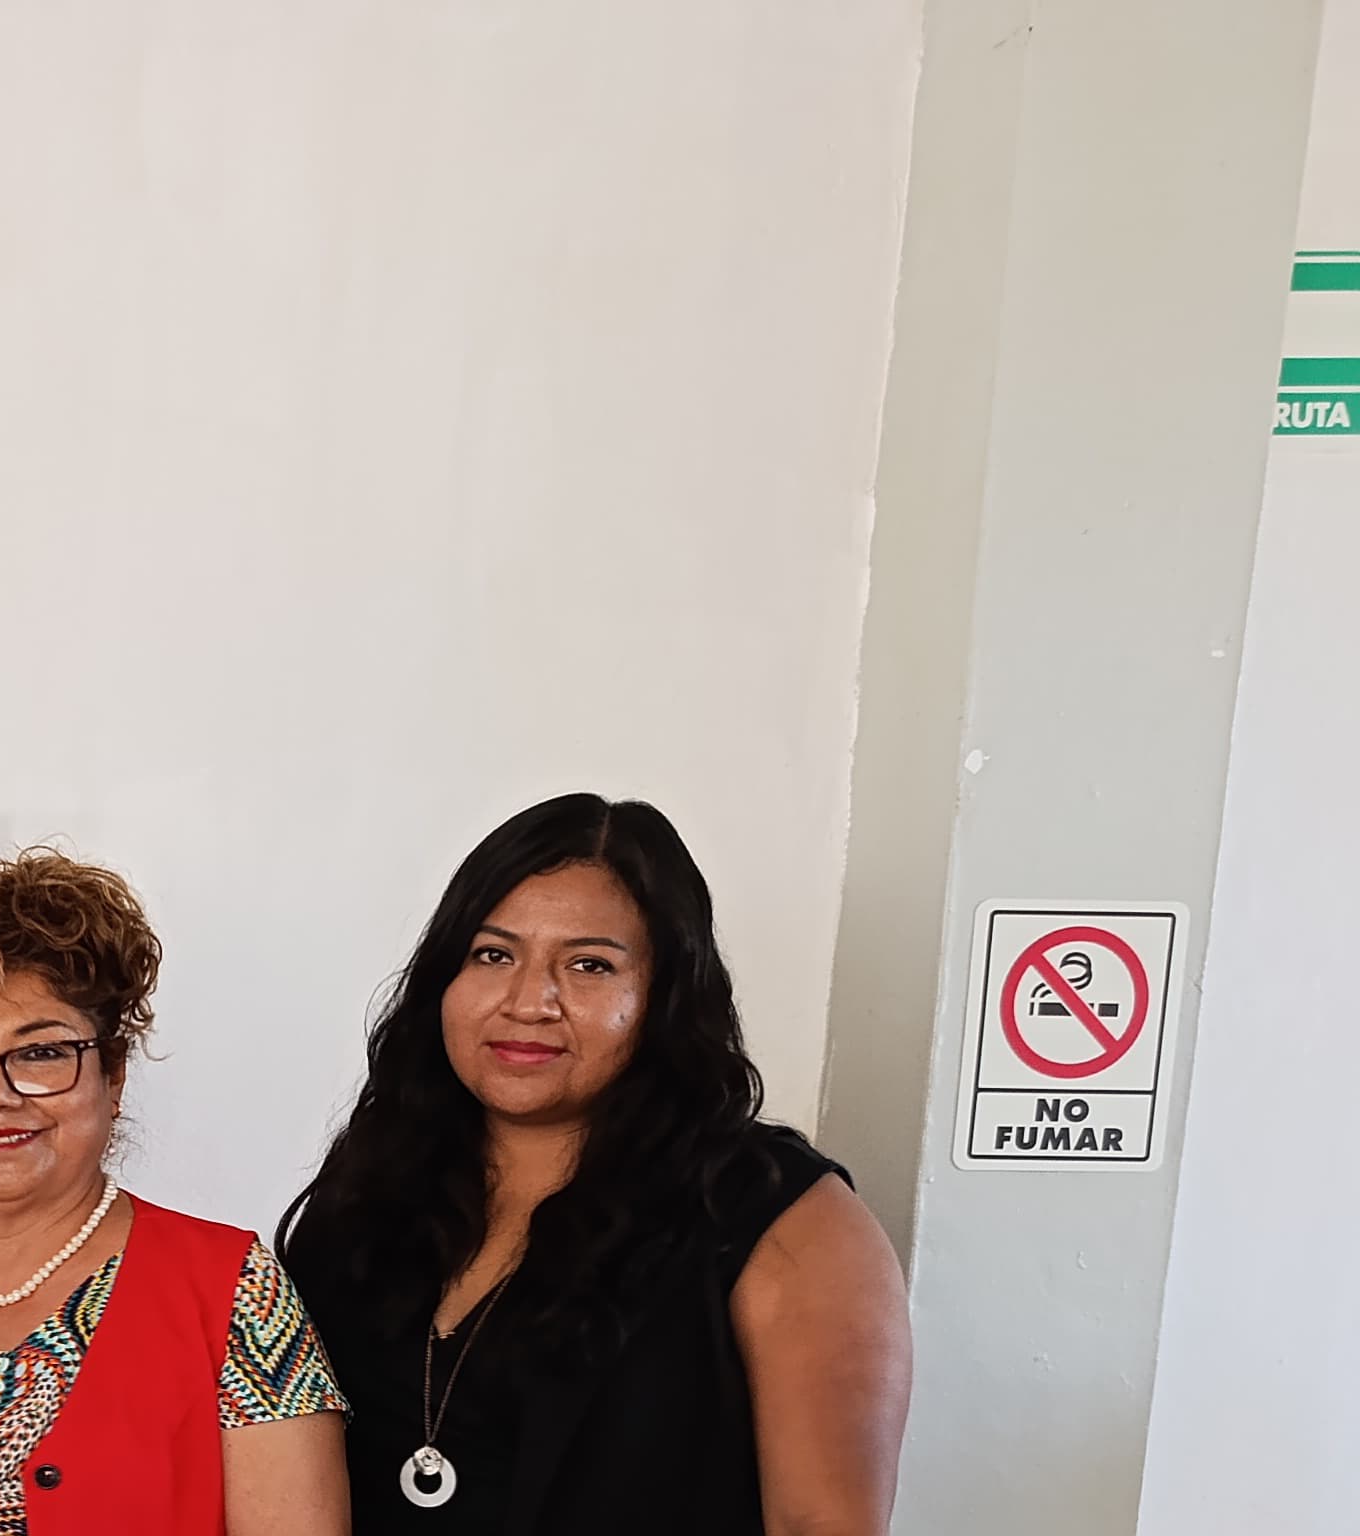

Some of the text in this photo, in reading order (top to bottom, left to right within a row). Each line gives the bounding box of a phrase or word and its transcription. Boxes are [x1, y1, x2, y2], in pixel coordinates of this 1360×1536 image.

[1273, 401, 1351, 429] RUTA
[1035, 1098, 1090, 1123] NO
[994, 1126, 1124, 1151] FUMAR
